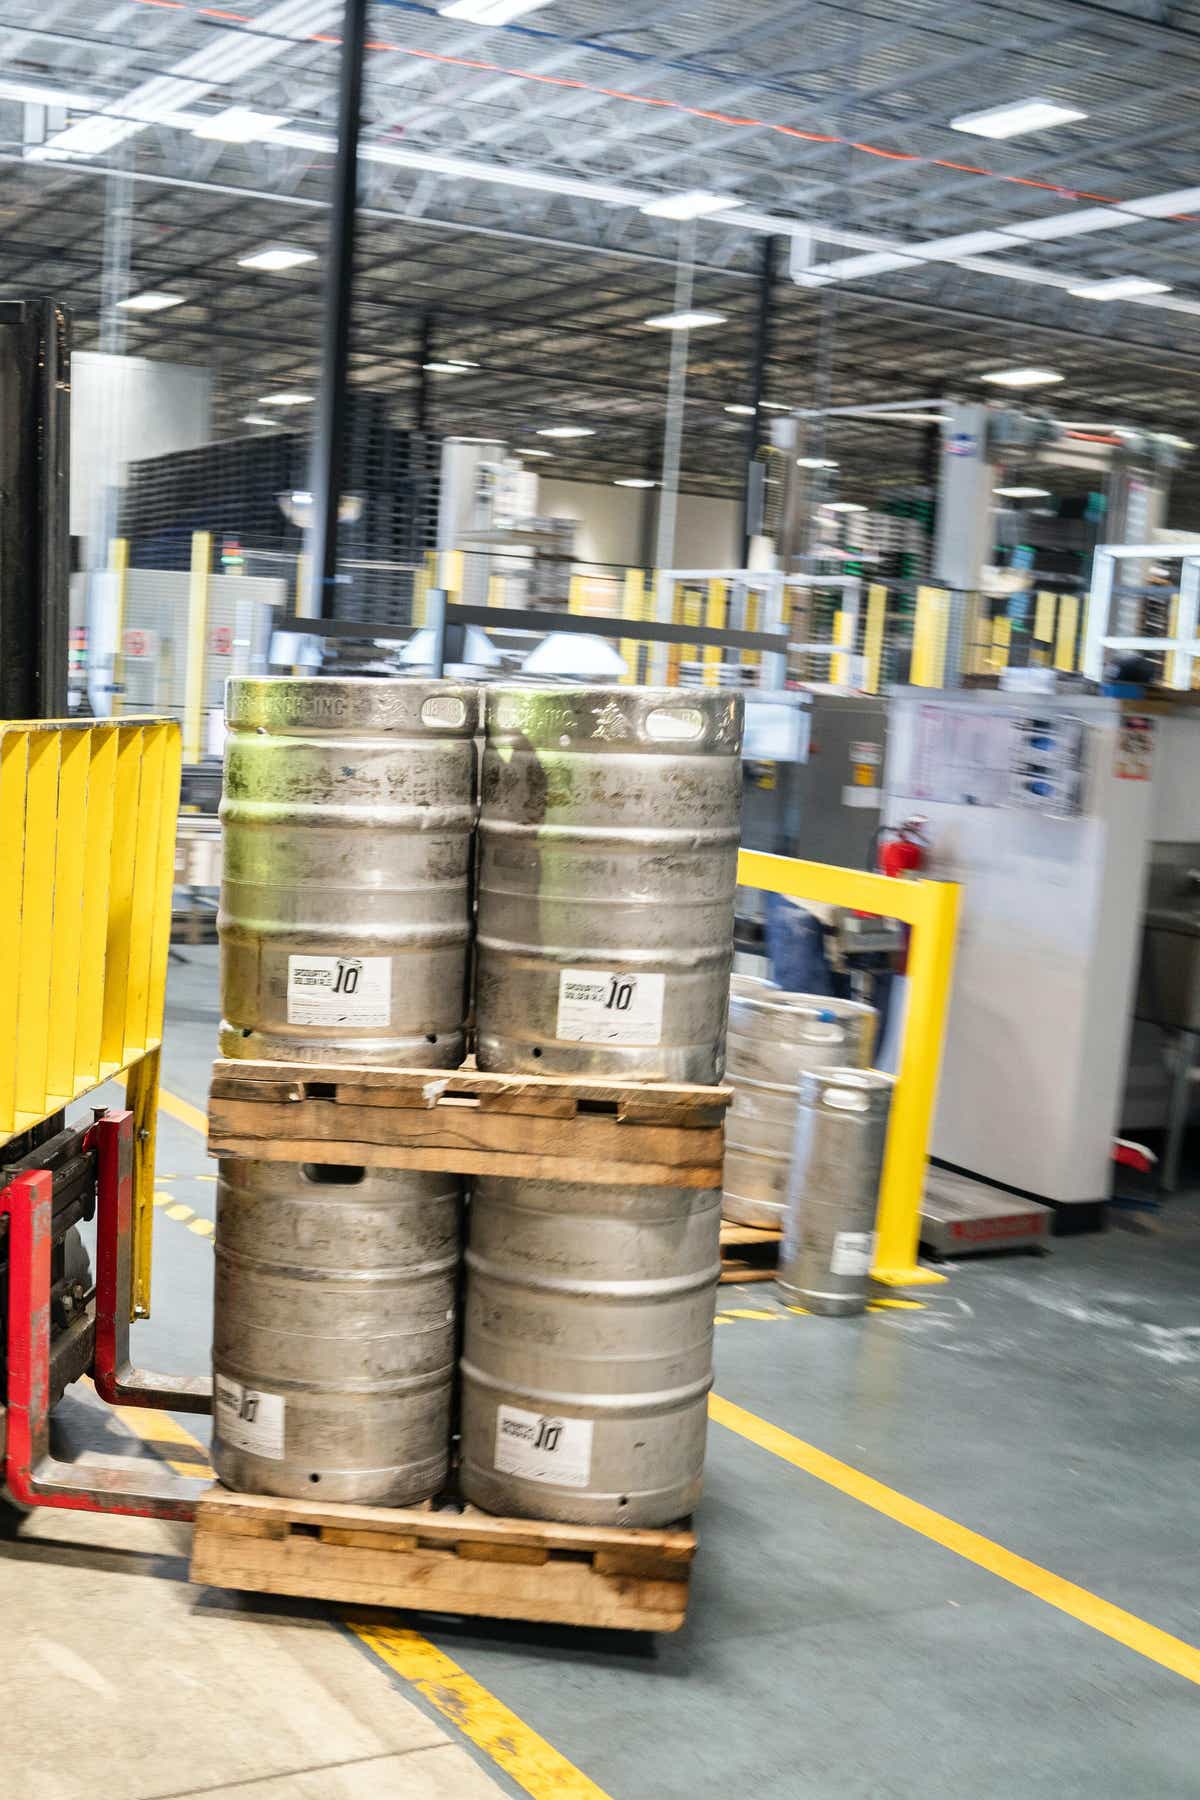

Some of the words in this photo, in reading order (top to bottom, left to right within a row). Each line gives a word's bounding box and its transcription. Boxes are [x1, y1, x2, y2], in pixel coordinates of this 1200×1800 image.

[332, 965, 360, 994] 10
[604, 981, 634, 1011] 10
[534, 1422, 562, 1451] 10
